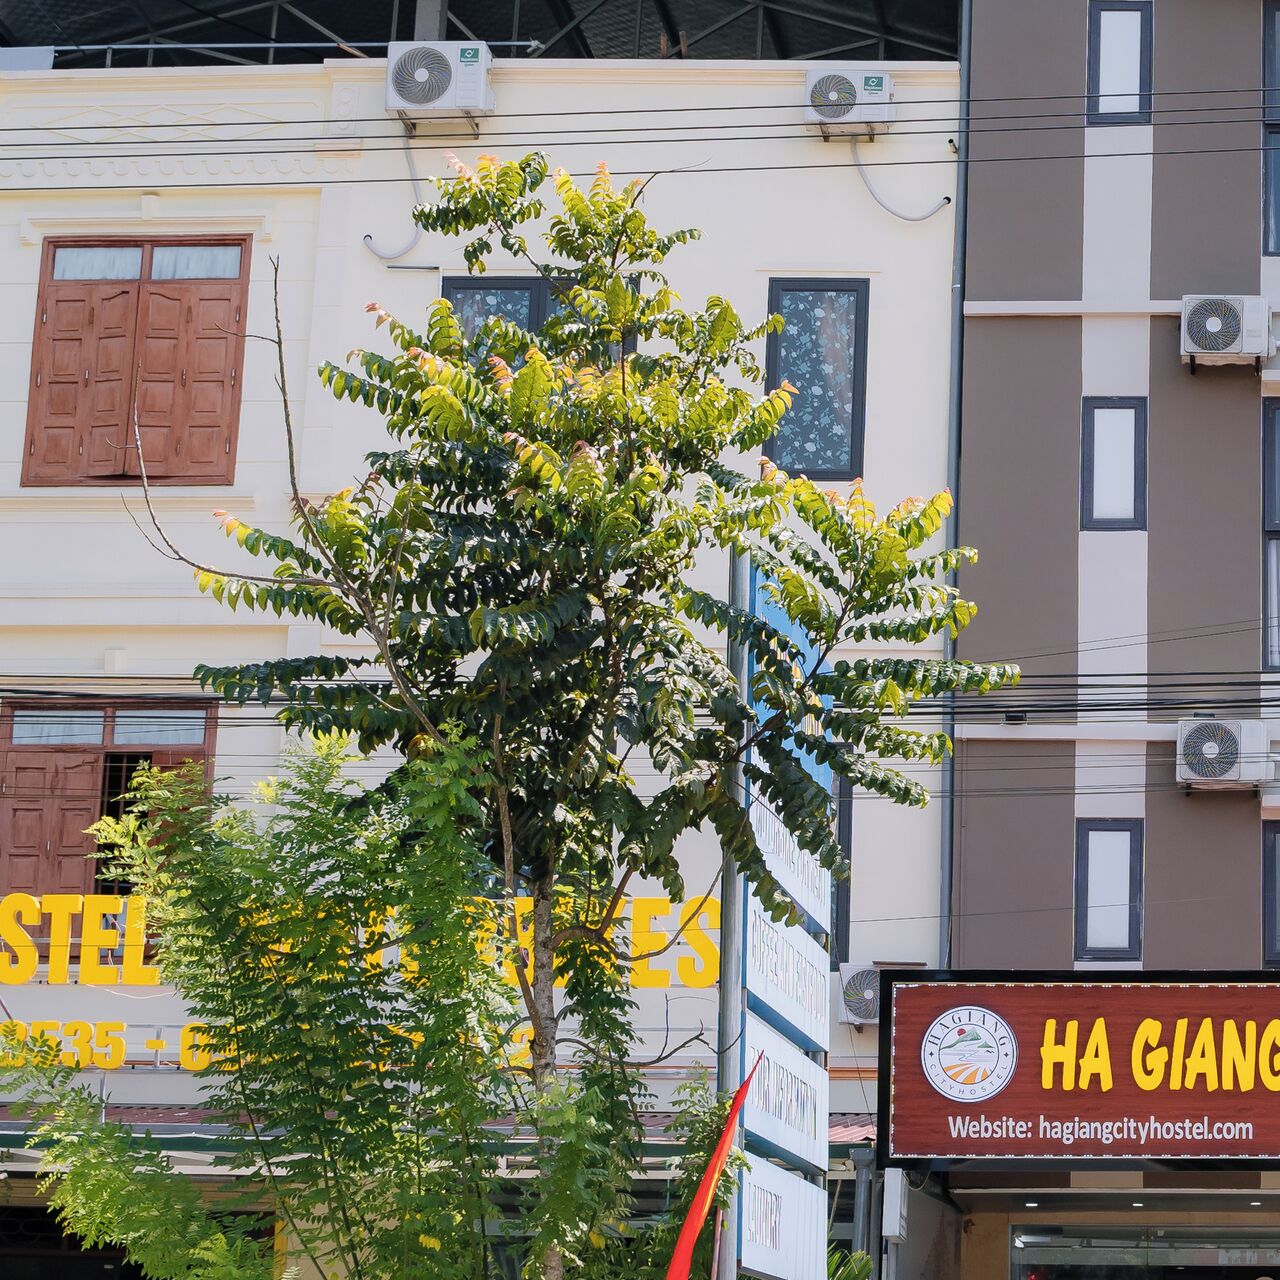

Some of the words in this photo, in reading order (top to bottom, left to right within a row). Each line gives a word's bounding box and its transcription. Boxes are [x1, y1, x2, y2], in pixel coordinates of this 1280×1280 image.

[1040, 1016, 1113, 1092] HA
[948, 1114, 1032, 1139] Website:
[1039, 1114, 1254, 1145] hagiangcityhostel.com
[747, 1182, 782, 1251] LAUNDRY
